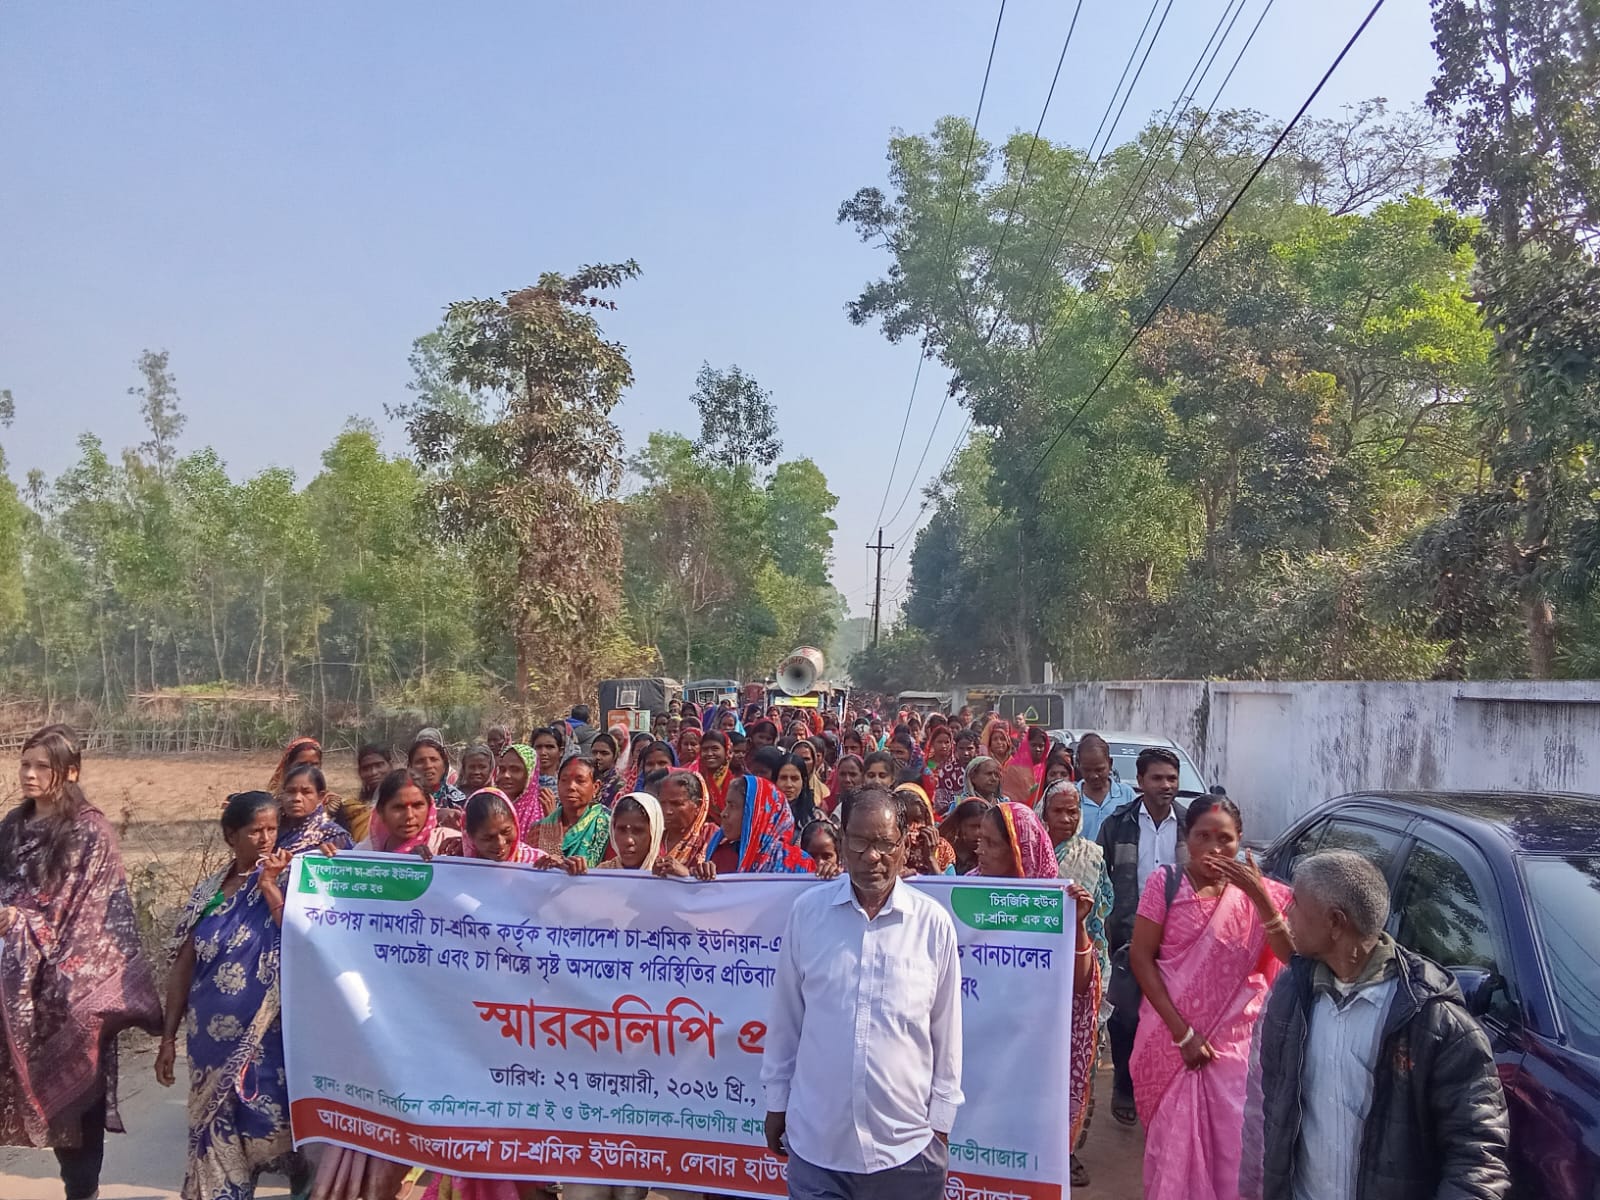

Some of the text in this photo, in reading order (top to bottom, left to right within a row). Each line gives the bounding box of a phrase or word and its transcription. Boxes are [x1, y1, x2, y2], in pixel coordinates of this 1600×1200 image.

[352, 882, 367, 893] এক
[370, 883, 384, 894] হও
[354, 865, 390, 879] চা-শ্রমিক
[391, 867, 428, 881] ইউনিয়ন
[974, 911, 1060, 930] চা-শ্রমিক এক হও
[1032, 894, 1058, 910] হউক
[368, 909, 426, 936] নামধারী
[430, 915, 492, 940] চা-শ্রমিক
[496, 918, 542, 952] কর্তৃক
[546, 925, 620, 949] বাংলাদেশ
[624, 925, 692, 951] চা-শ্রমিক
[696, 927, 782, 955] ইউনিয়ন-এ
[970, 942, 1053, 970] বানচালের
[373, 940, 433, 967] অপচেষ্টা
[438, 946, 470, 971] এবং
[475, 949, 491, 971] চা
[495, 947, 532, 975] শিল্পে
[536, 950, 561, 983] সৃষ্ট
[566, 957, 634, 981] অসন্তোষ
[639, 954, 717, 989] পরিস্থিতির
[961, 976, 980, 1001] বং
[472, 994, 724, 1060] স্মারকলিপি
[554, 1071, 579, 1092] ২৭
[586, 1069, 659, 1099] জানুয়ারী,
[667, 1078, 719, 1100] ২০২৬
[345, 1083, 374, 1104] প্রধান
[378, 1089, 424, 1115] নির্বাচন
[428, 1094, 502, 1118] কমিশন-বা
[507, 1101, 523, 1119] চা
[526, 1101, 539, 1120] শ্র
[544, 1099, 557, 1121] ই
[562, 1104, 573, 1120] ও
[578, 1100, 737, 1134] উপ-পরিচালক-বিভাগীয়
[949, 1139, 1029, 1169] লভীবাজার
[407, 1132, 494, 1162] বাংলাদেশ
[500, 1135, 583, 1165] চা-শ্রমিক
[589, 1138, 672, 1176] ইউনিয়ন,
[680, 1151, 739, 1178] লেবার
